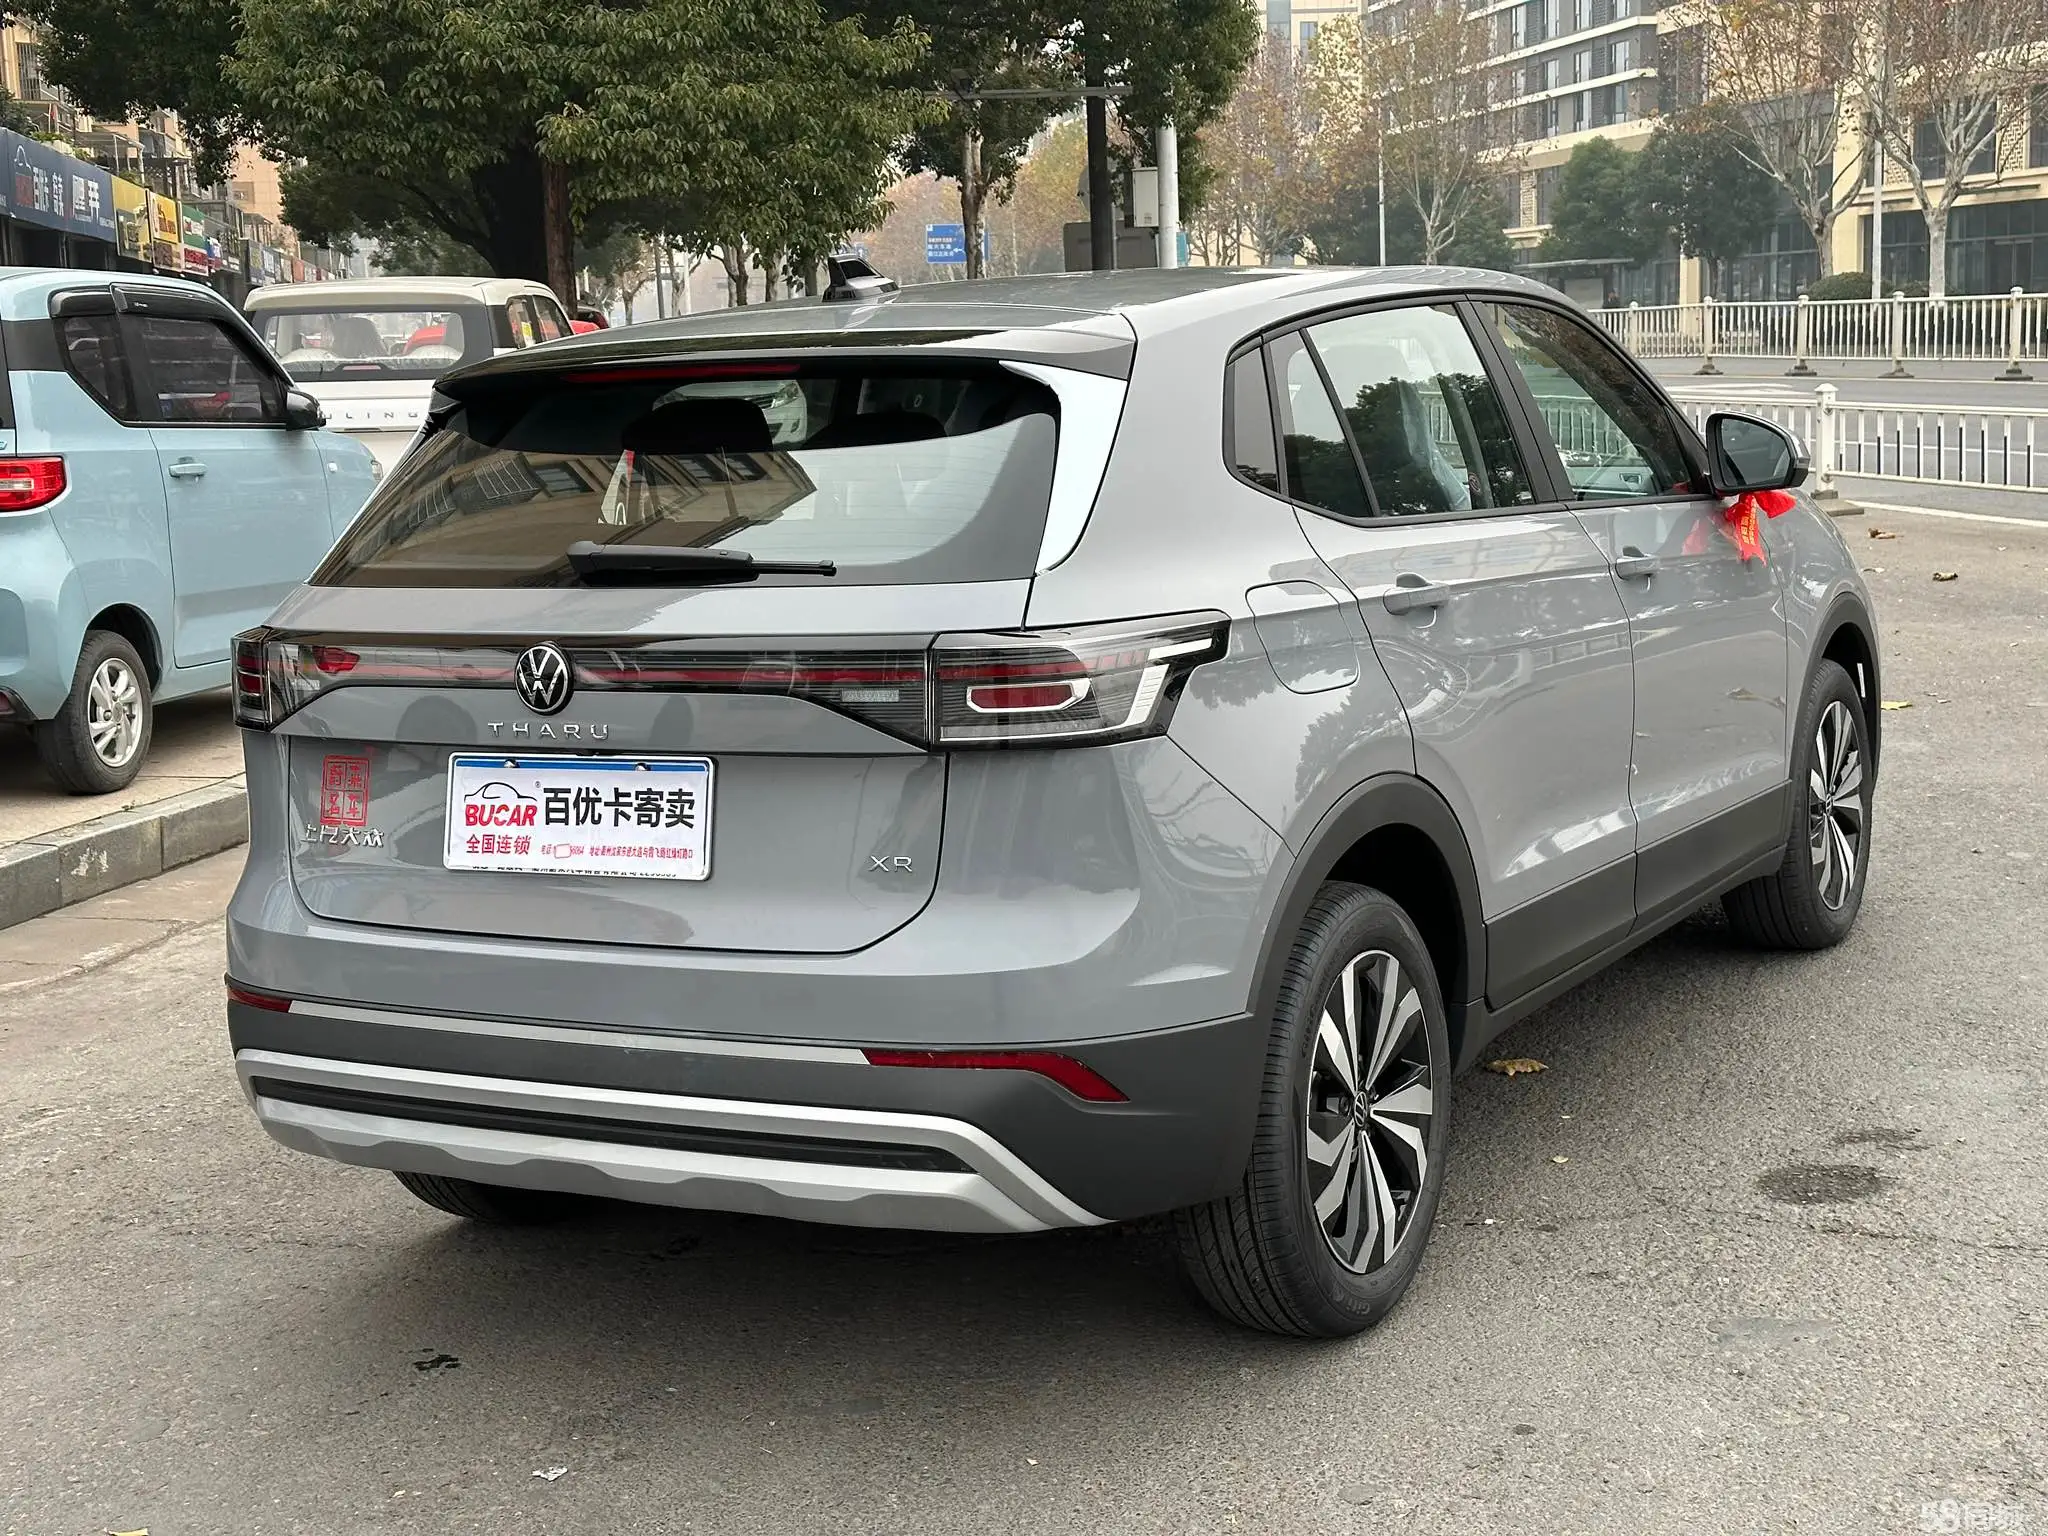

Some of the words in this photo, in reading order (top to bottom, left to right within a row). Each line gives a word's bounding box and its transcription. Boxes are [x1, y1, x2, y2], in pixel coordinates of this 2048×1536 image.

[488, 721, 610, 741] THARU
[465, 803, 538, 827] BUCAR
[543, 786, 695, 828] 百优卡寄卖
[300, 823, 384, 848] 上汽大众
[466, 833, 531, 855] 全国连锁
[868, 855, 913, 872] XR
